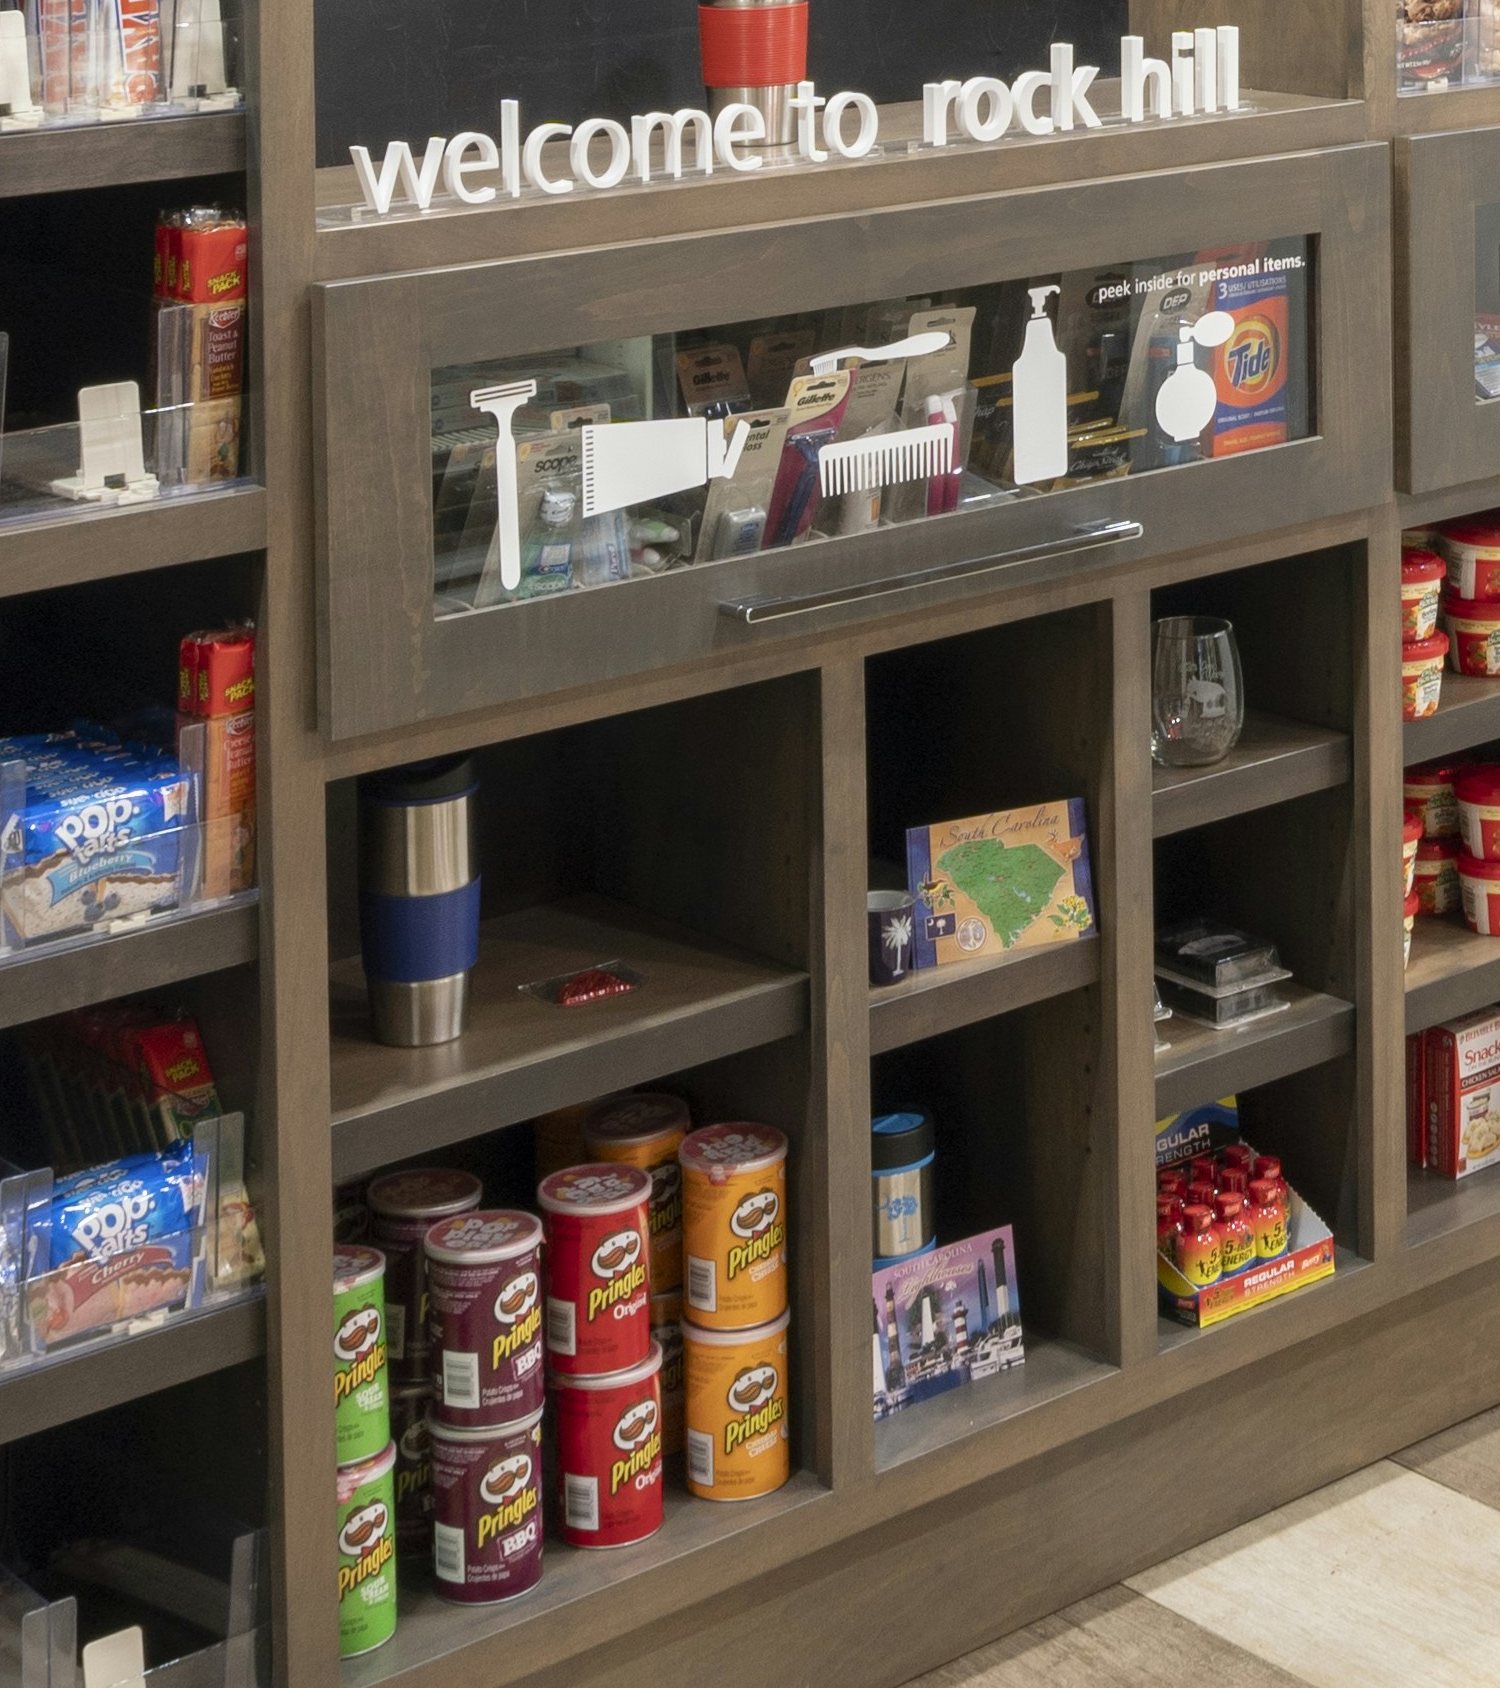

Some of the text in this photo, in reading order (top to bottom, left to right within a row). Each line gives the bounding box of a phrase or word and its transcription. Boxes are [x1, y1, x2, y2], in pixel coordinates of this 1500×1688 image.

[349, 25, 1239, 214] welcome to rock hill
[1099, 255, 1306, 304] peek inside for personal items.
[1218, 282, 1229, 300] 3
[1163, 293, 1189, 310] DEP
[692, 371, 731, 386] Gillette
[1228, 338, 1271, 389] Tide
[797, 392, 836, 406] Gillette
[534, 453, 579, 474] scope
[991, 806, 1060, 836] Carolina
[67, 852, 134, 885] Blueberry
[91, 1249, 146, 1285] Cherry
[727, 1213, 784, 1280] Pringles
[893, 1242, 974, 1280] SOUTH CAROLINA
[588, 1253, 647, 1323] Pringles
[896, 1263, 975, 1310] Lighthouses
[1244, 1260, 1296, 1288] REGULAR
[491, 1303, 542, 1370] Pringles
[724, 1388, 783, 1455] Pringles
[610, 1427, 662, 1496] Pringles
[477, 1481, 537, 1548] Pringles
[501, 1521, 536, 1560] BBQ
[338, 1532, 393, 1600] Pringles
